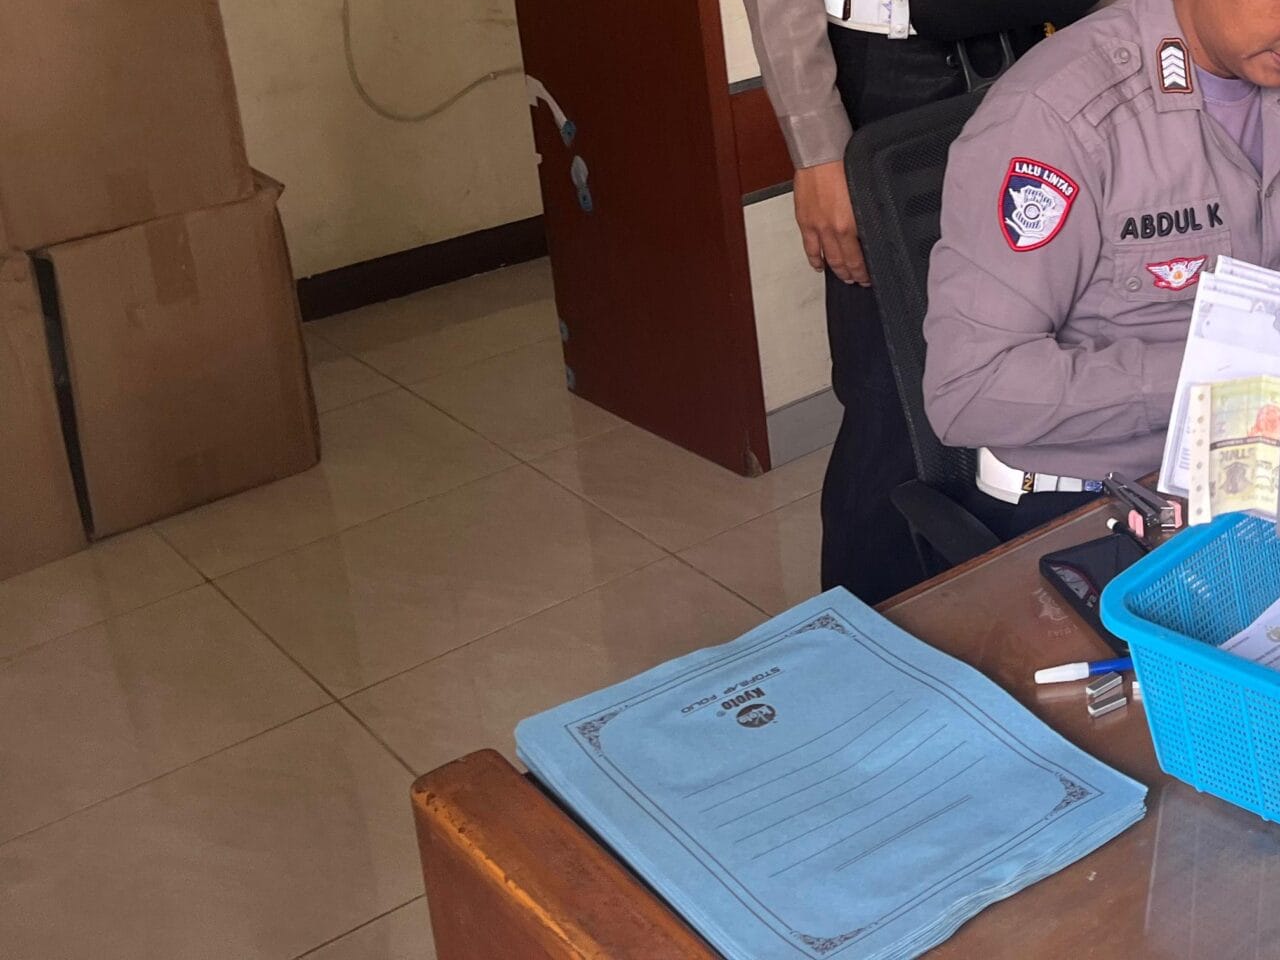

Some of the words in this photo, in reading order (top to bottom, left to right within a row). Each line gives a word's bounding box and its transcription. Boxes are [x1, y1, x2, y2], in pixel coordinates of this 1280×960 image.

[1015, 162, 1041, 177] LALU
[1043, 170, 1074, 196] LINTAS
[1120, 207, 1203, 240] ABDUL
[1206, 202, 1224, 228] K
[721, 687, 766, 710] Kyoto
